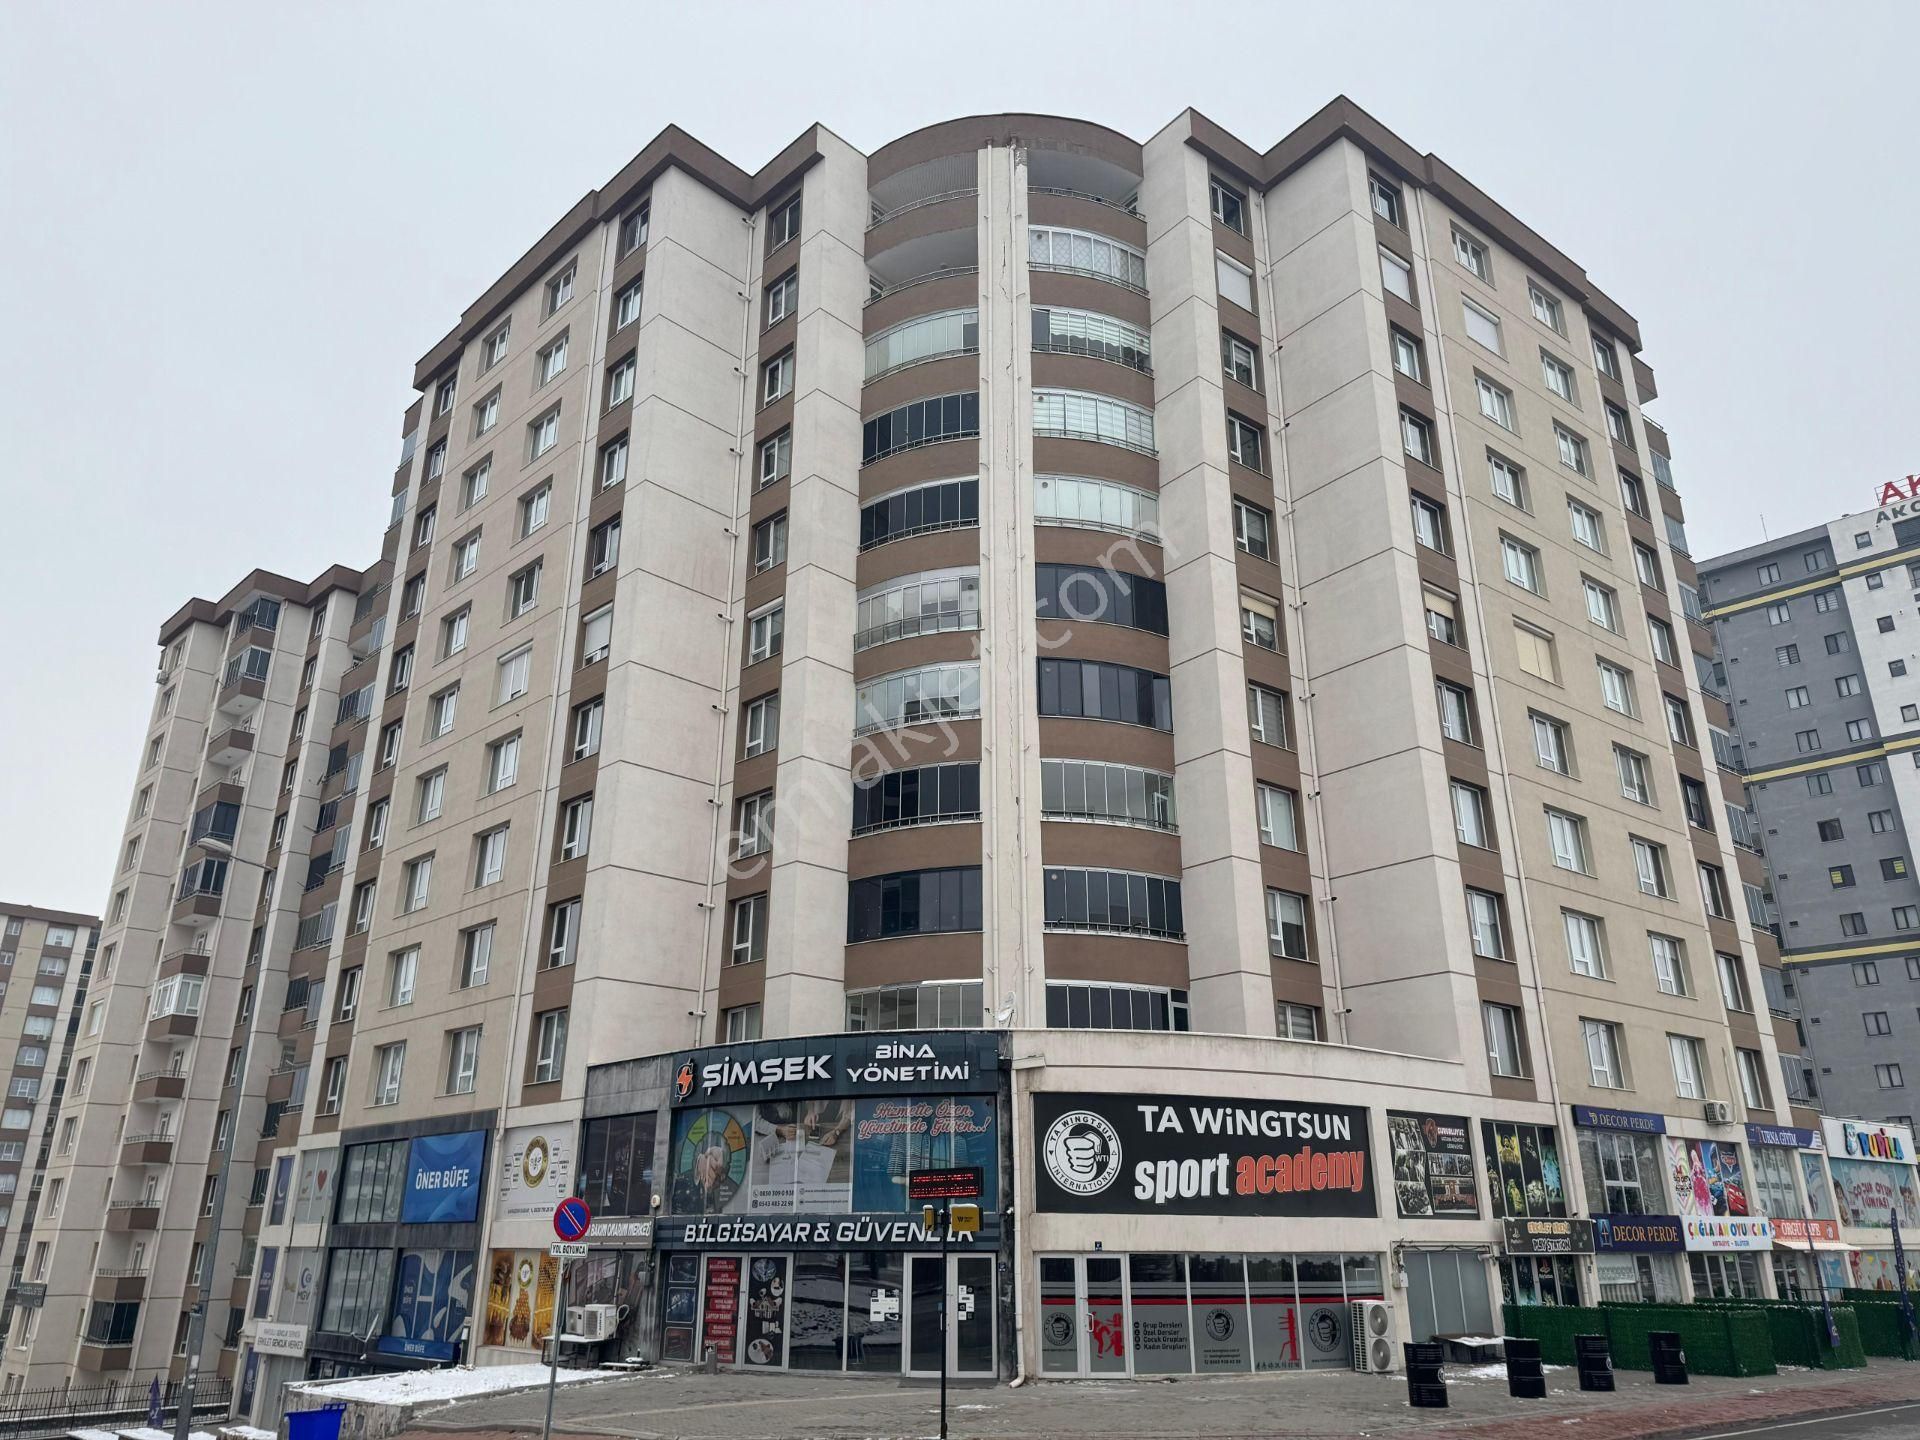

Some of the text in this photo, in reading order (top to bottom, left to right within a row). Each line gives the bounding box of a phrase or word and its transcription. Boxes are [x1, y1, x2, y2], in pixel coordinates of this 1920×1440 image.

[875, 1040, 936, 1059] BİNA
[702, 1054, 833, 1096] ŞİMŞEK
[846, 1060, 969, 1083] YÖNETİMİ
[873, 1099, 974, 1118] Hizmette Özen,
[1061, 1115, 1114, 1142] WINGTSUN
[1137, 1105, 1184, 1133] TA
[1599, 1114, 1656, 1130] DECOR PERDE
[858, 1119, 928, 1140] Yönetimde
[1094, 1154, 1109, 1162] WTI
[415, 1165, 470, 1190] ÖNER BÜFE
[1052, 1165, 1115, 1191] INTERNATIONAL
[1134, 1146, 1366, 1204] sport academy
[683, 1217, 811, 1243] BİLGİSAYAR
[813, 1222, 831, 1242] &
[1613, 1226, 1679, 1242] DECOR PERDE
[1688, 1220, 1768, 1240] ÇAĞLAYAN OYUNCAK
[552, 1244, 586, 1255] YOL BOYUNCA
[1142, 1321, 1157, 1329] Grup
[404, 1342, 415, 1353] ÖNER
